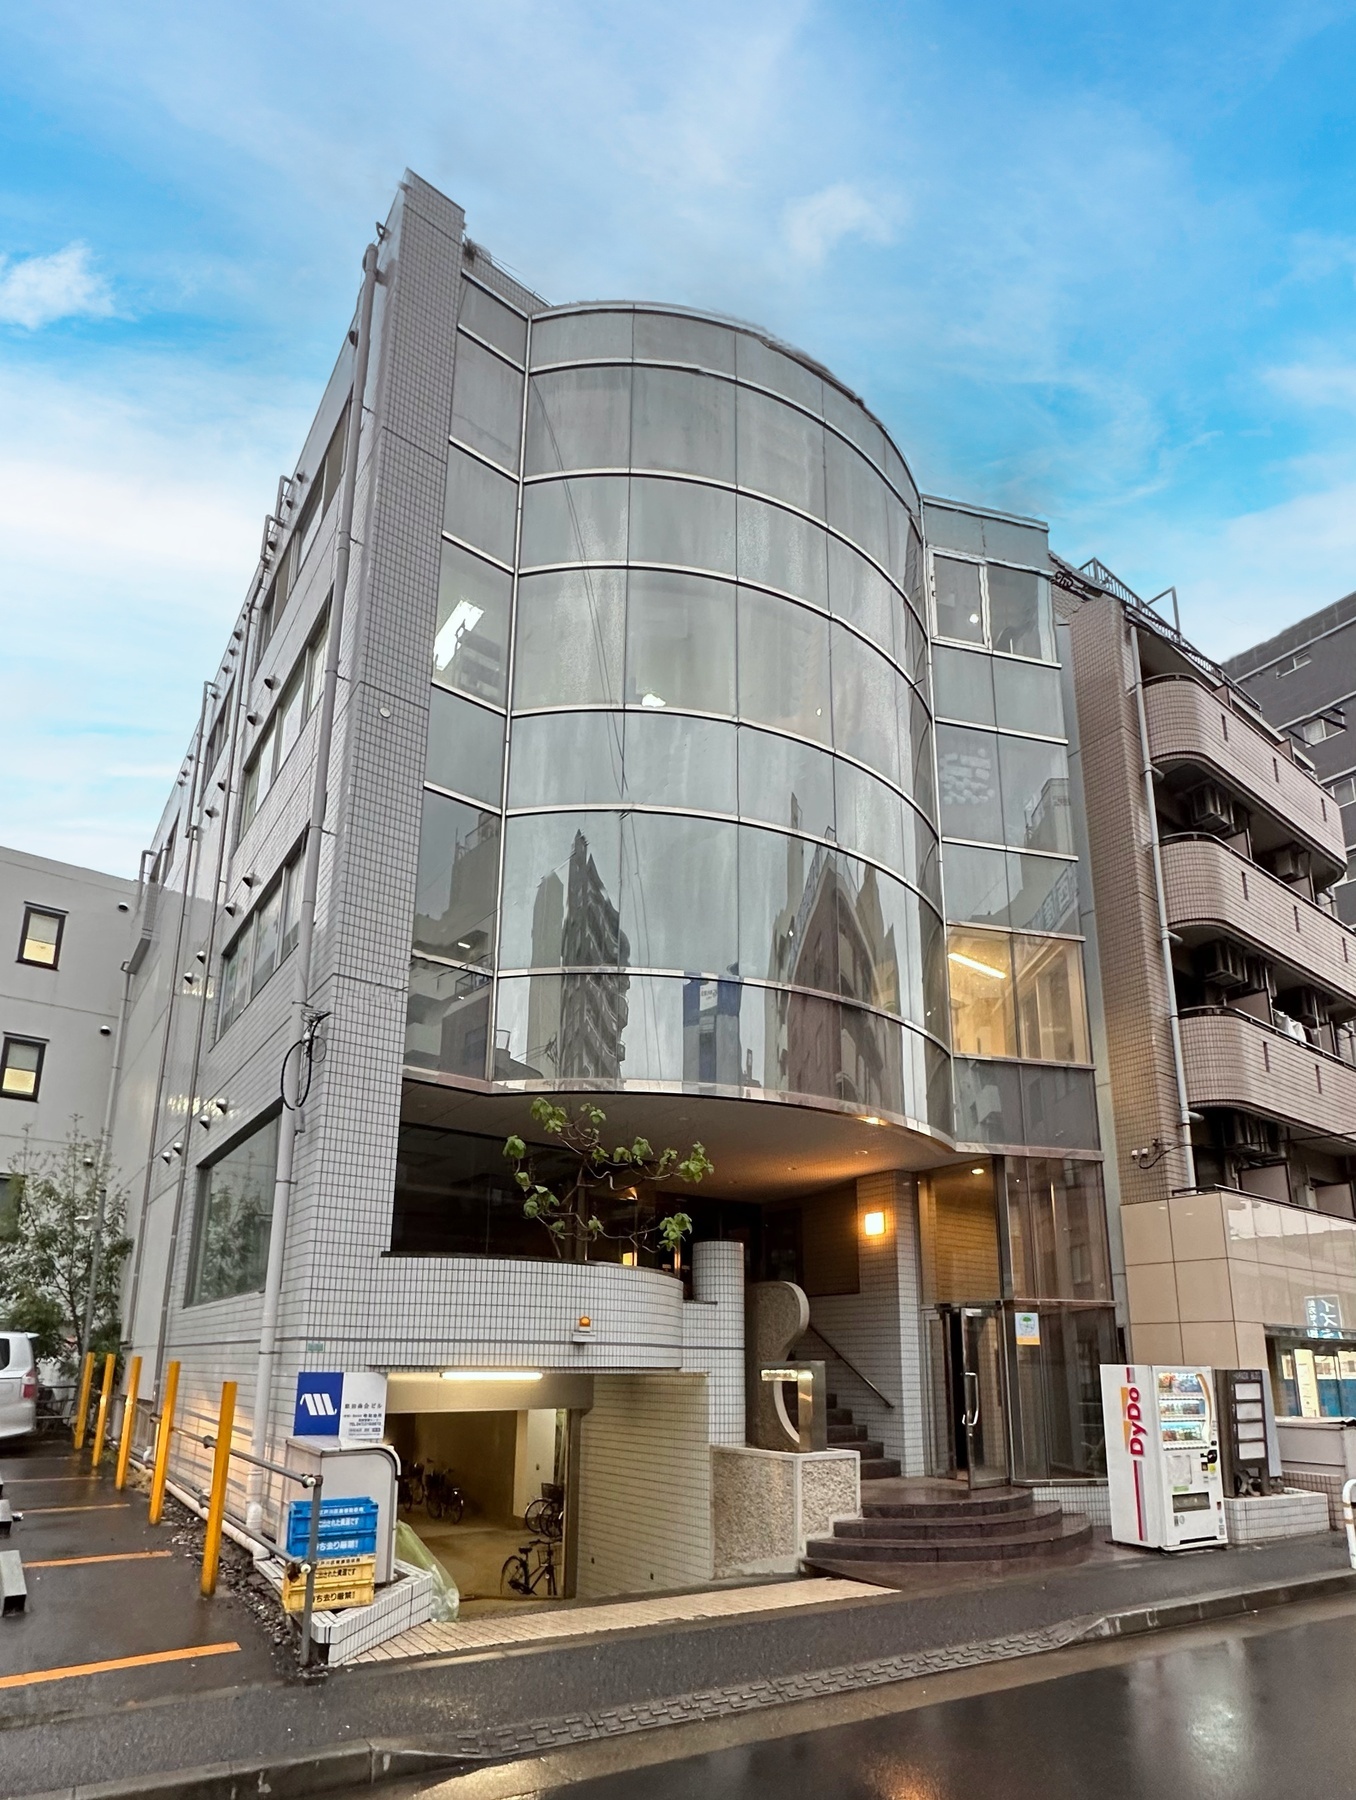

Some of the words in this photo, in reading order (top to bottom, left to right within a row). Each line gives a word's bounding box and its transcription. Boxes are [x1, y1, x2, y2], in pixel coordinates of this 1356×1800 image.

[1128, 1387, 1147, 1455] DyDo
[316, 1540, 358, 1551] ち去り厳禁!
[312, 1592, 355, 1603] ち去り厳禁!
